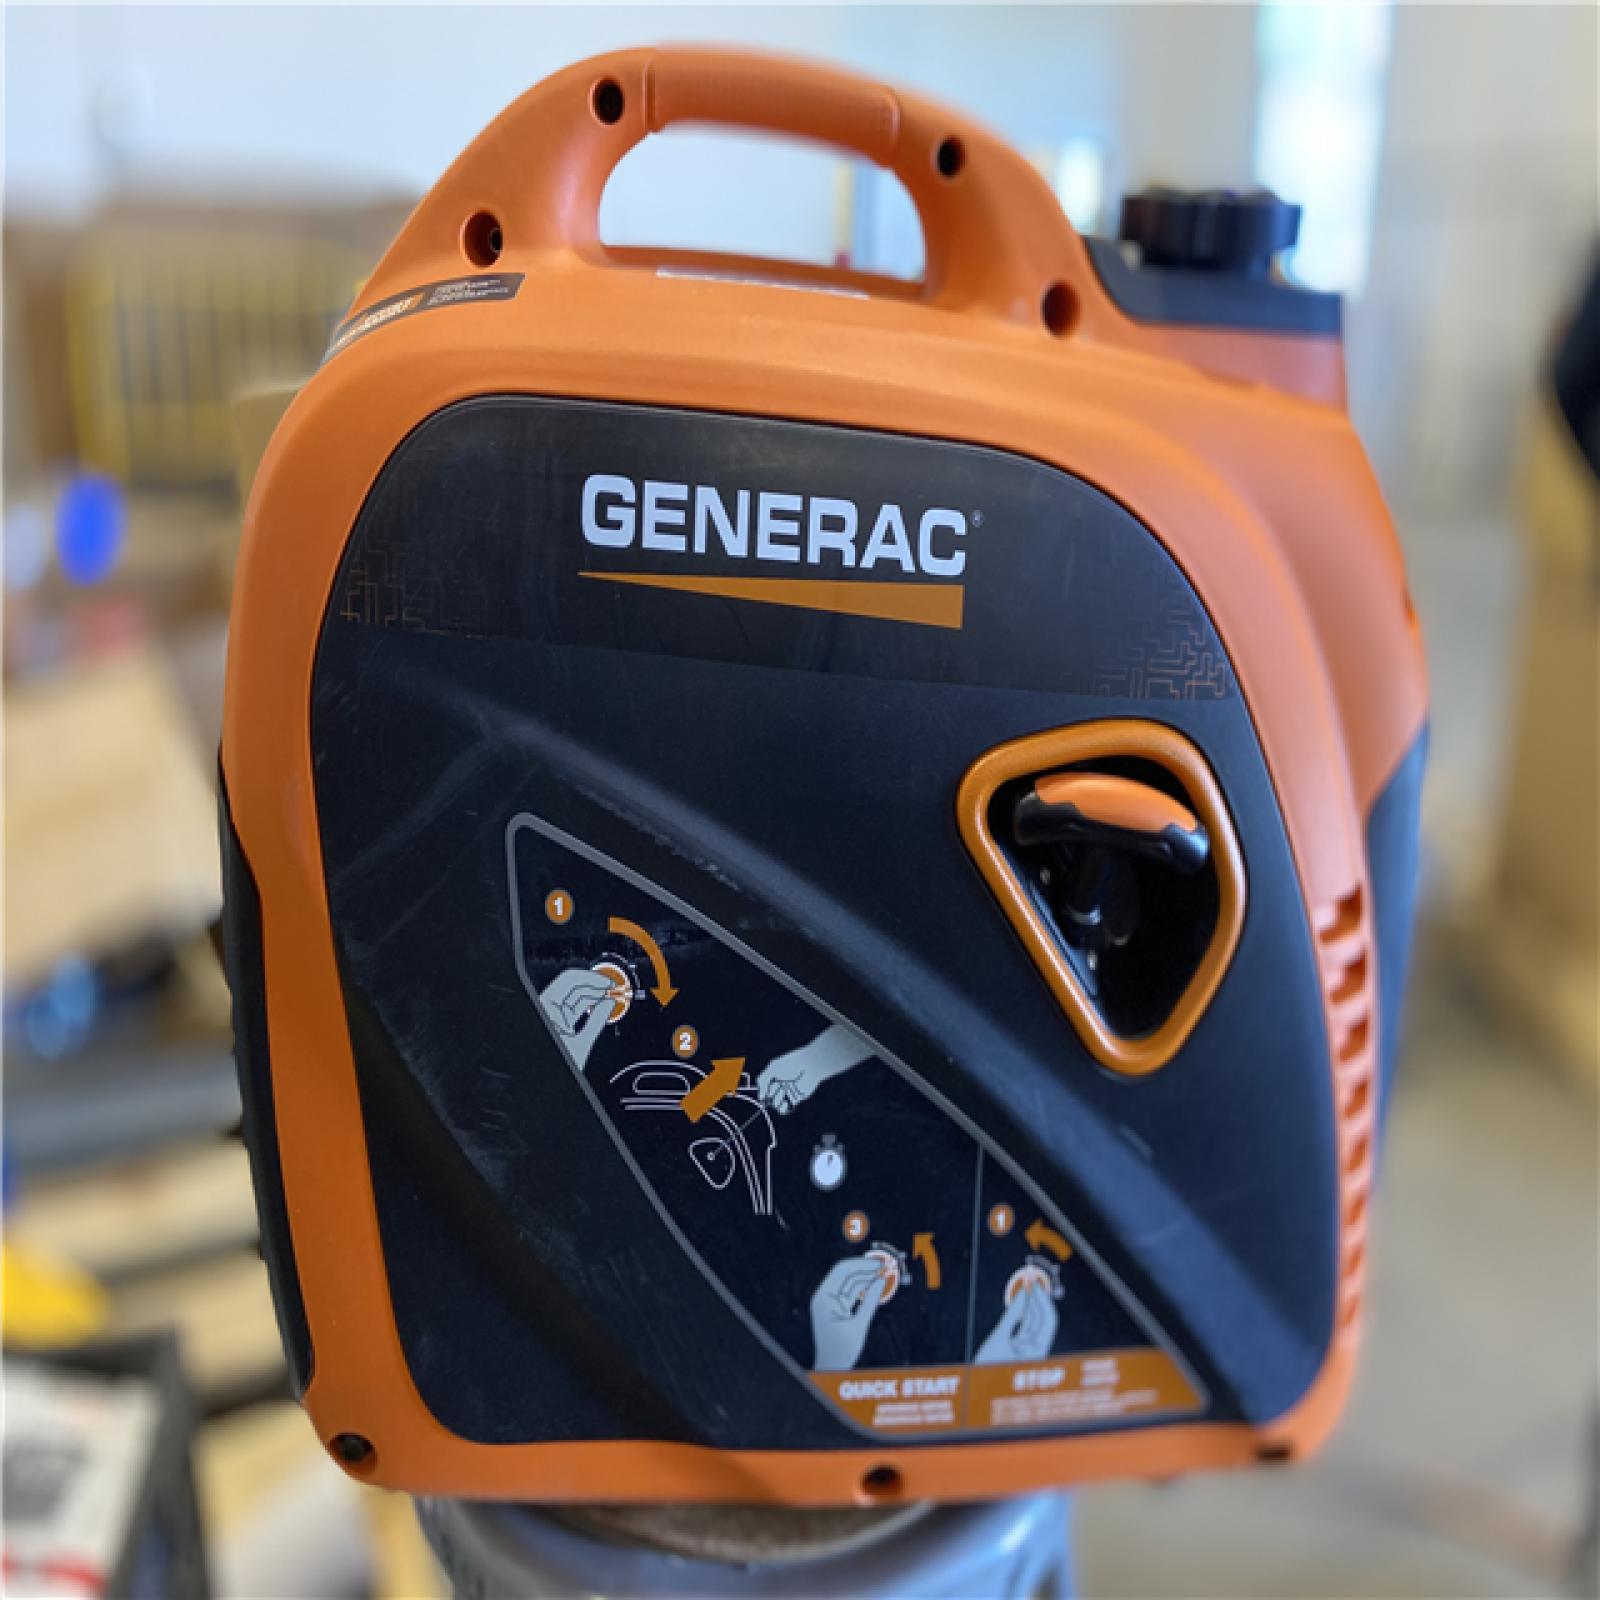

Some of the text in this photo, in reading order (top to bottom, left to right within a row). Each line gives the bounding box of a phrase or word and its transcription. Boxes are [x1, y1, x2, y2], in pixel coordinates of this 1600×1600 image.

[582, 474, 966, 576] GENERAC
[553, 895, 565, 917] 1
[678, 1031, 692, 1052] 2
[848, 1218, 862, 1237] 3
[839, 1375, 960, 1400] QUICK START
[1013, 1367, 1066, 1392] STOP
